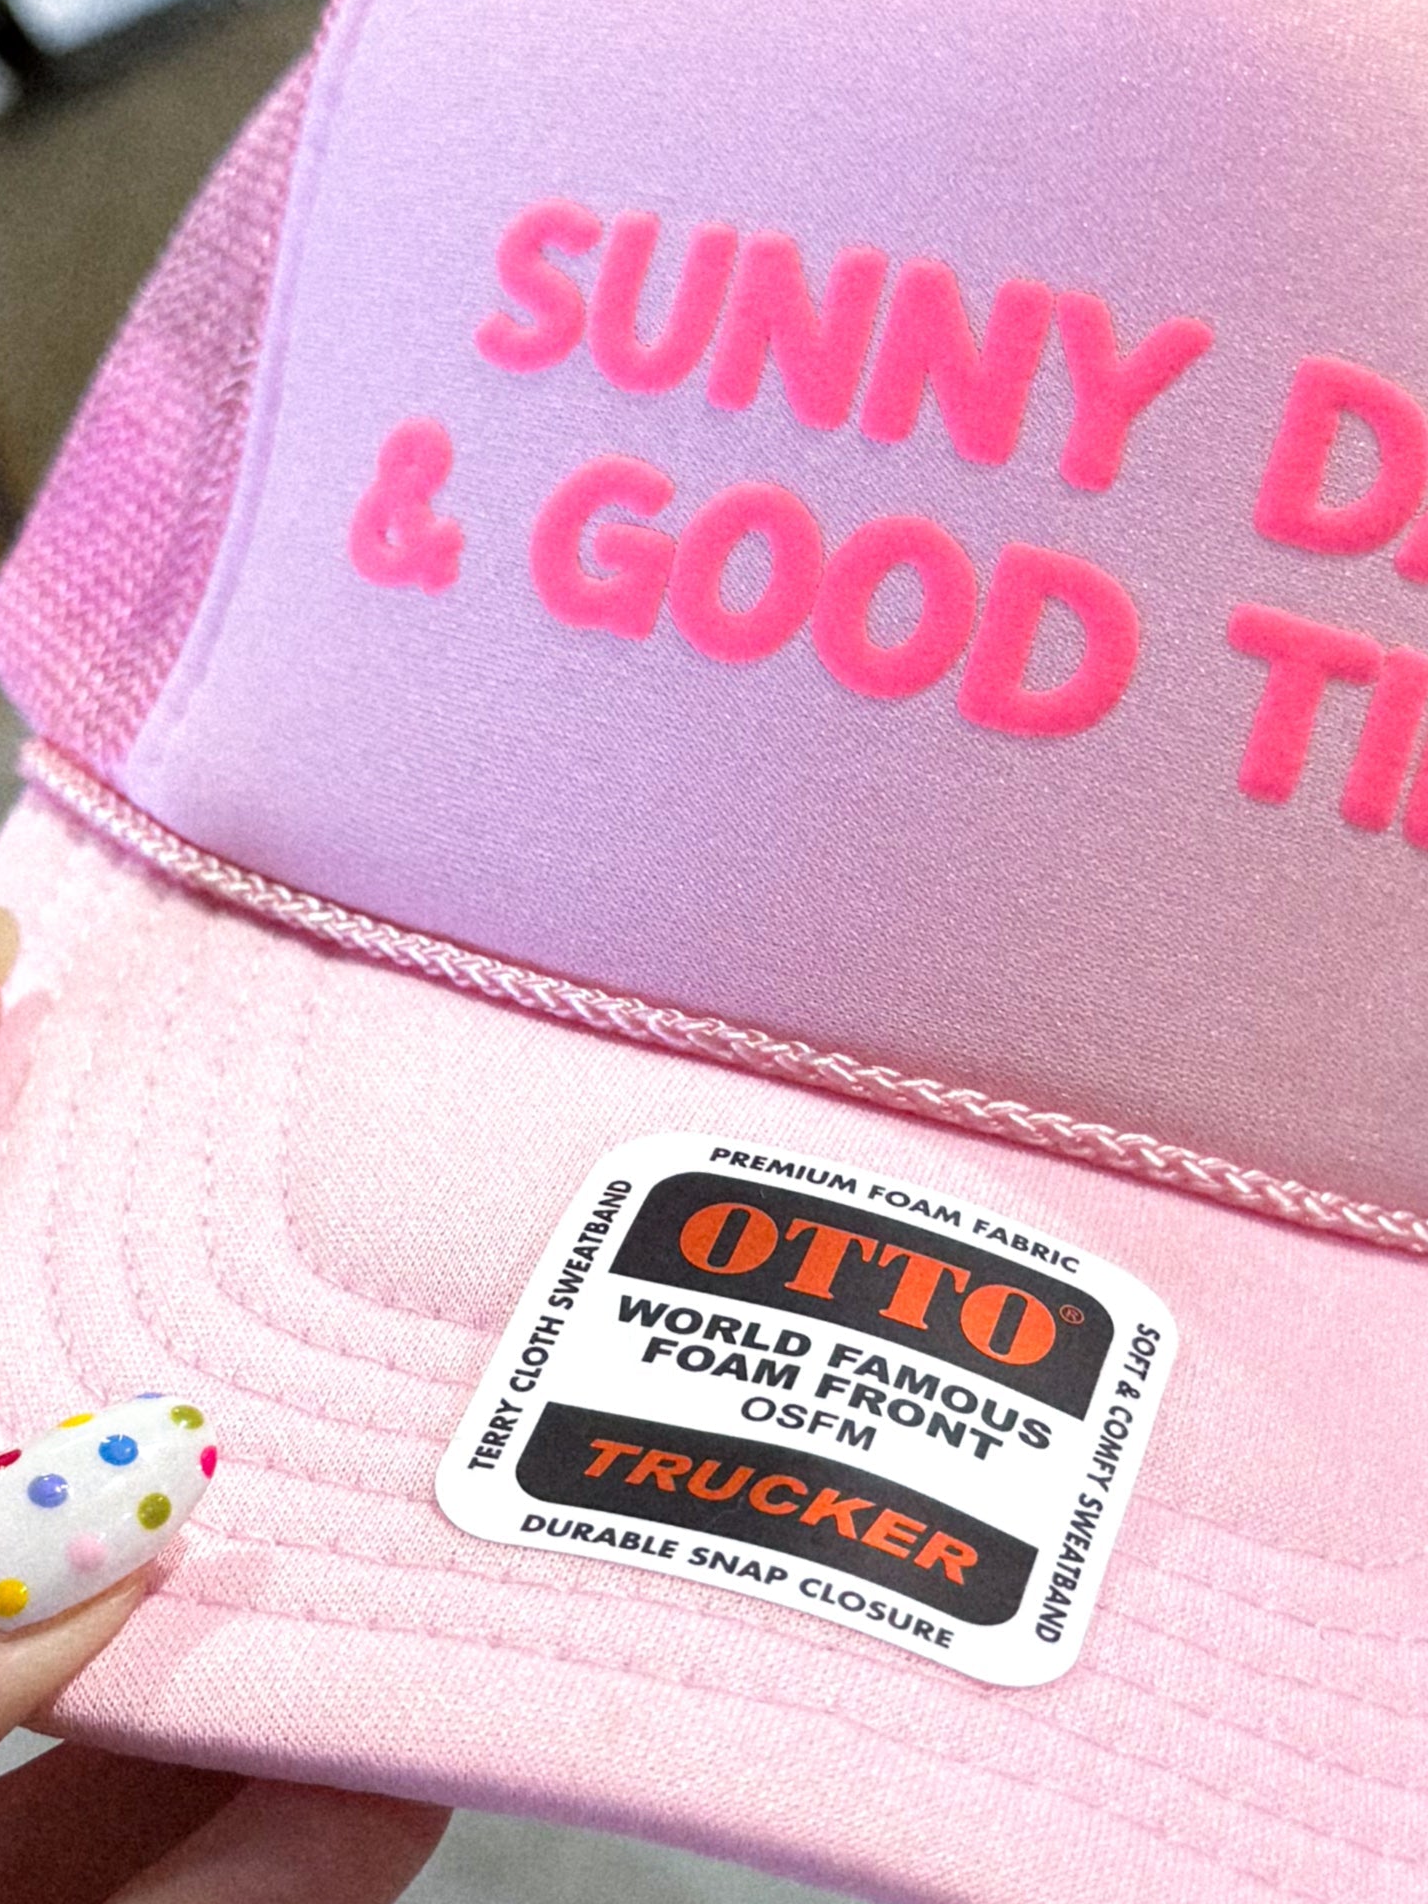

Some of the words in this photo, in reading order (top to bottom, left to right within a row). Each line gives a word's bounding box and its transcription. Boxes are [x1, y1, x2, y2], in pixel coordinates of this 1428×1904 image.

[475, 199, 1215, 494] SUNNY
[349, 417, 465, 595] &
[529, 453, 1141, 740] GOOD
[709, 1146, 858, 1195] PREMIUM
[867, 1184, 962, 1228] FOAM
[972, 1217, 1081, 1274] FABRIC
[467, 1397, 524, 1471] TERRY
[509, 1314, 566, 1395] CLOTH
[547, 1179, 633, 1311] SWEATBAND
[617, 1294, 813, 1358] WORLD
[827, 1342, 1053, 1451] FAMOUS
[1114, 1379, 1142, 1400] &
[1123, 1321, 1162, 1382] SOFT
[640, 1336, 802, 1391] FOAM
[813, 1373, 1005, 1461] FRONT
[740, 1395, 878, 1452] OSFM
[1086, 1404, 1134, 1493] COMFY
[583, 1437, 980, 1585] TRUCKER
[1034, 1492, 1104, 1645] SWEATBAND
[519, 1513, 680, 1560] DURABLE
[687, 1546, 789, 1586] SNAP
[798, 1577, 955, 1650] CLOSURE
